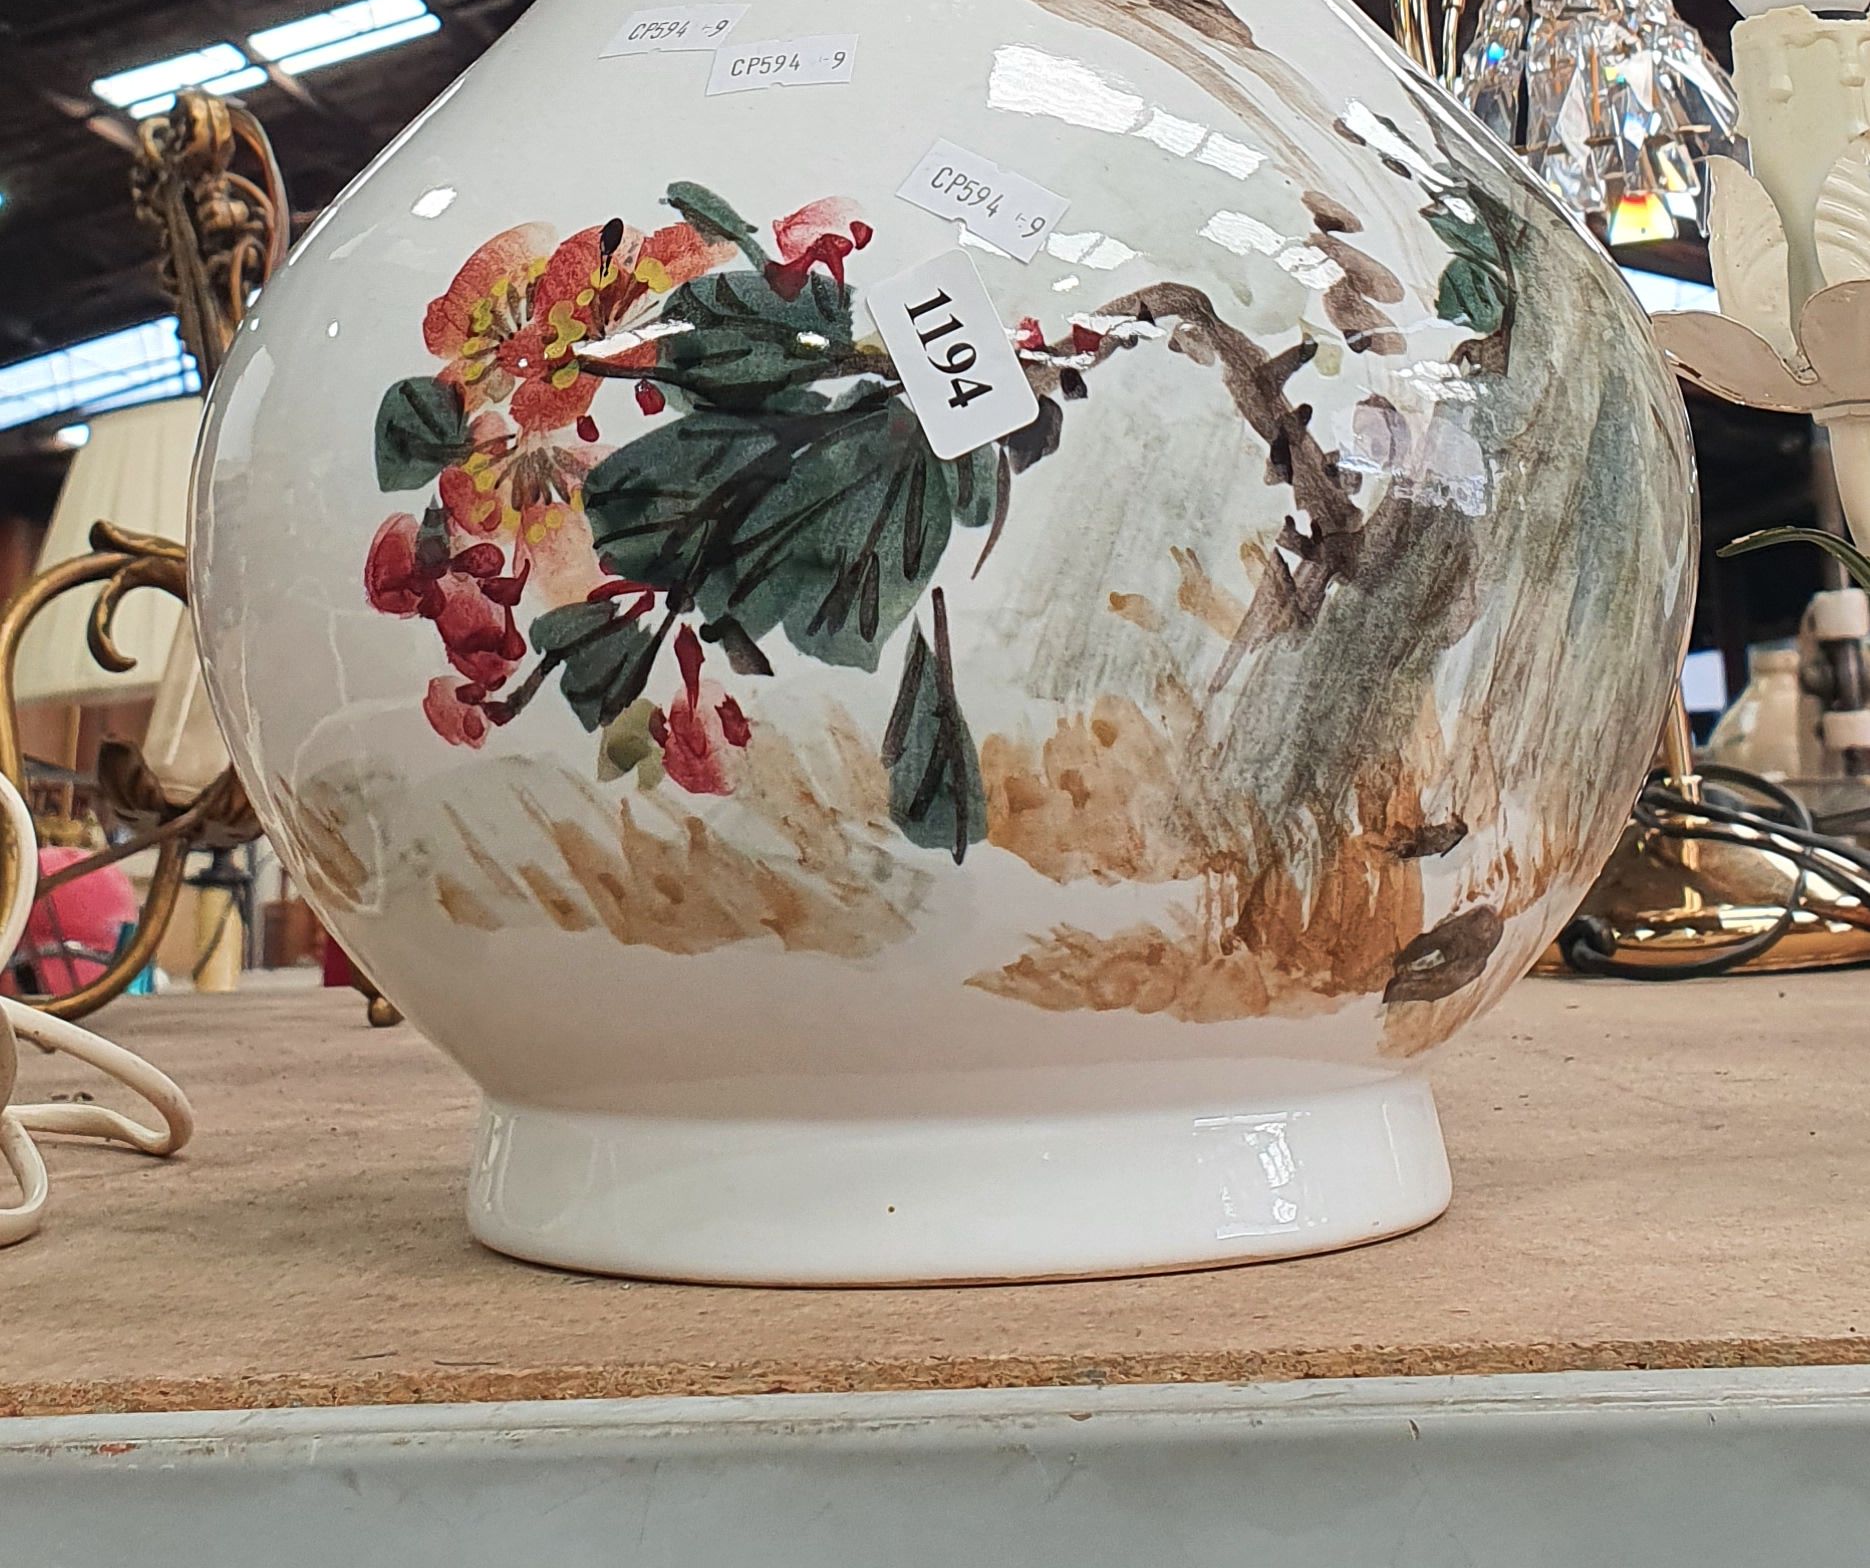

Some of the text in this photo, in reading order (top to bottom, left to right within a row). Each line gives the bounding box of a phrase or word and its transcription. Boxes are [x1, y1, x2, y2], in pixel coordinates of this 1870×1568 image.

[628, 20, 691, 41] CP594
[730, 52, 801, 77] CP594
[930, 166, 1004, 218] CP594
[903, 287, 994, 412] 1194
